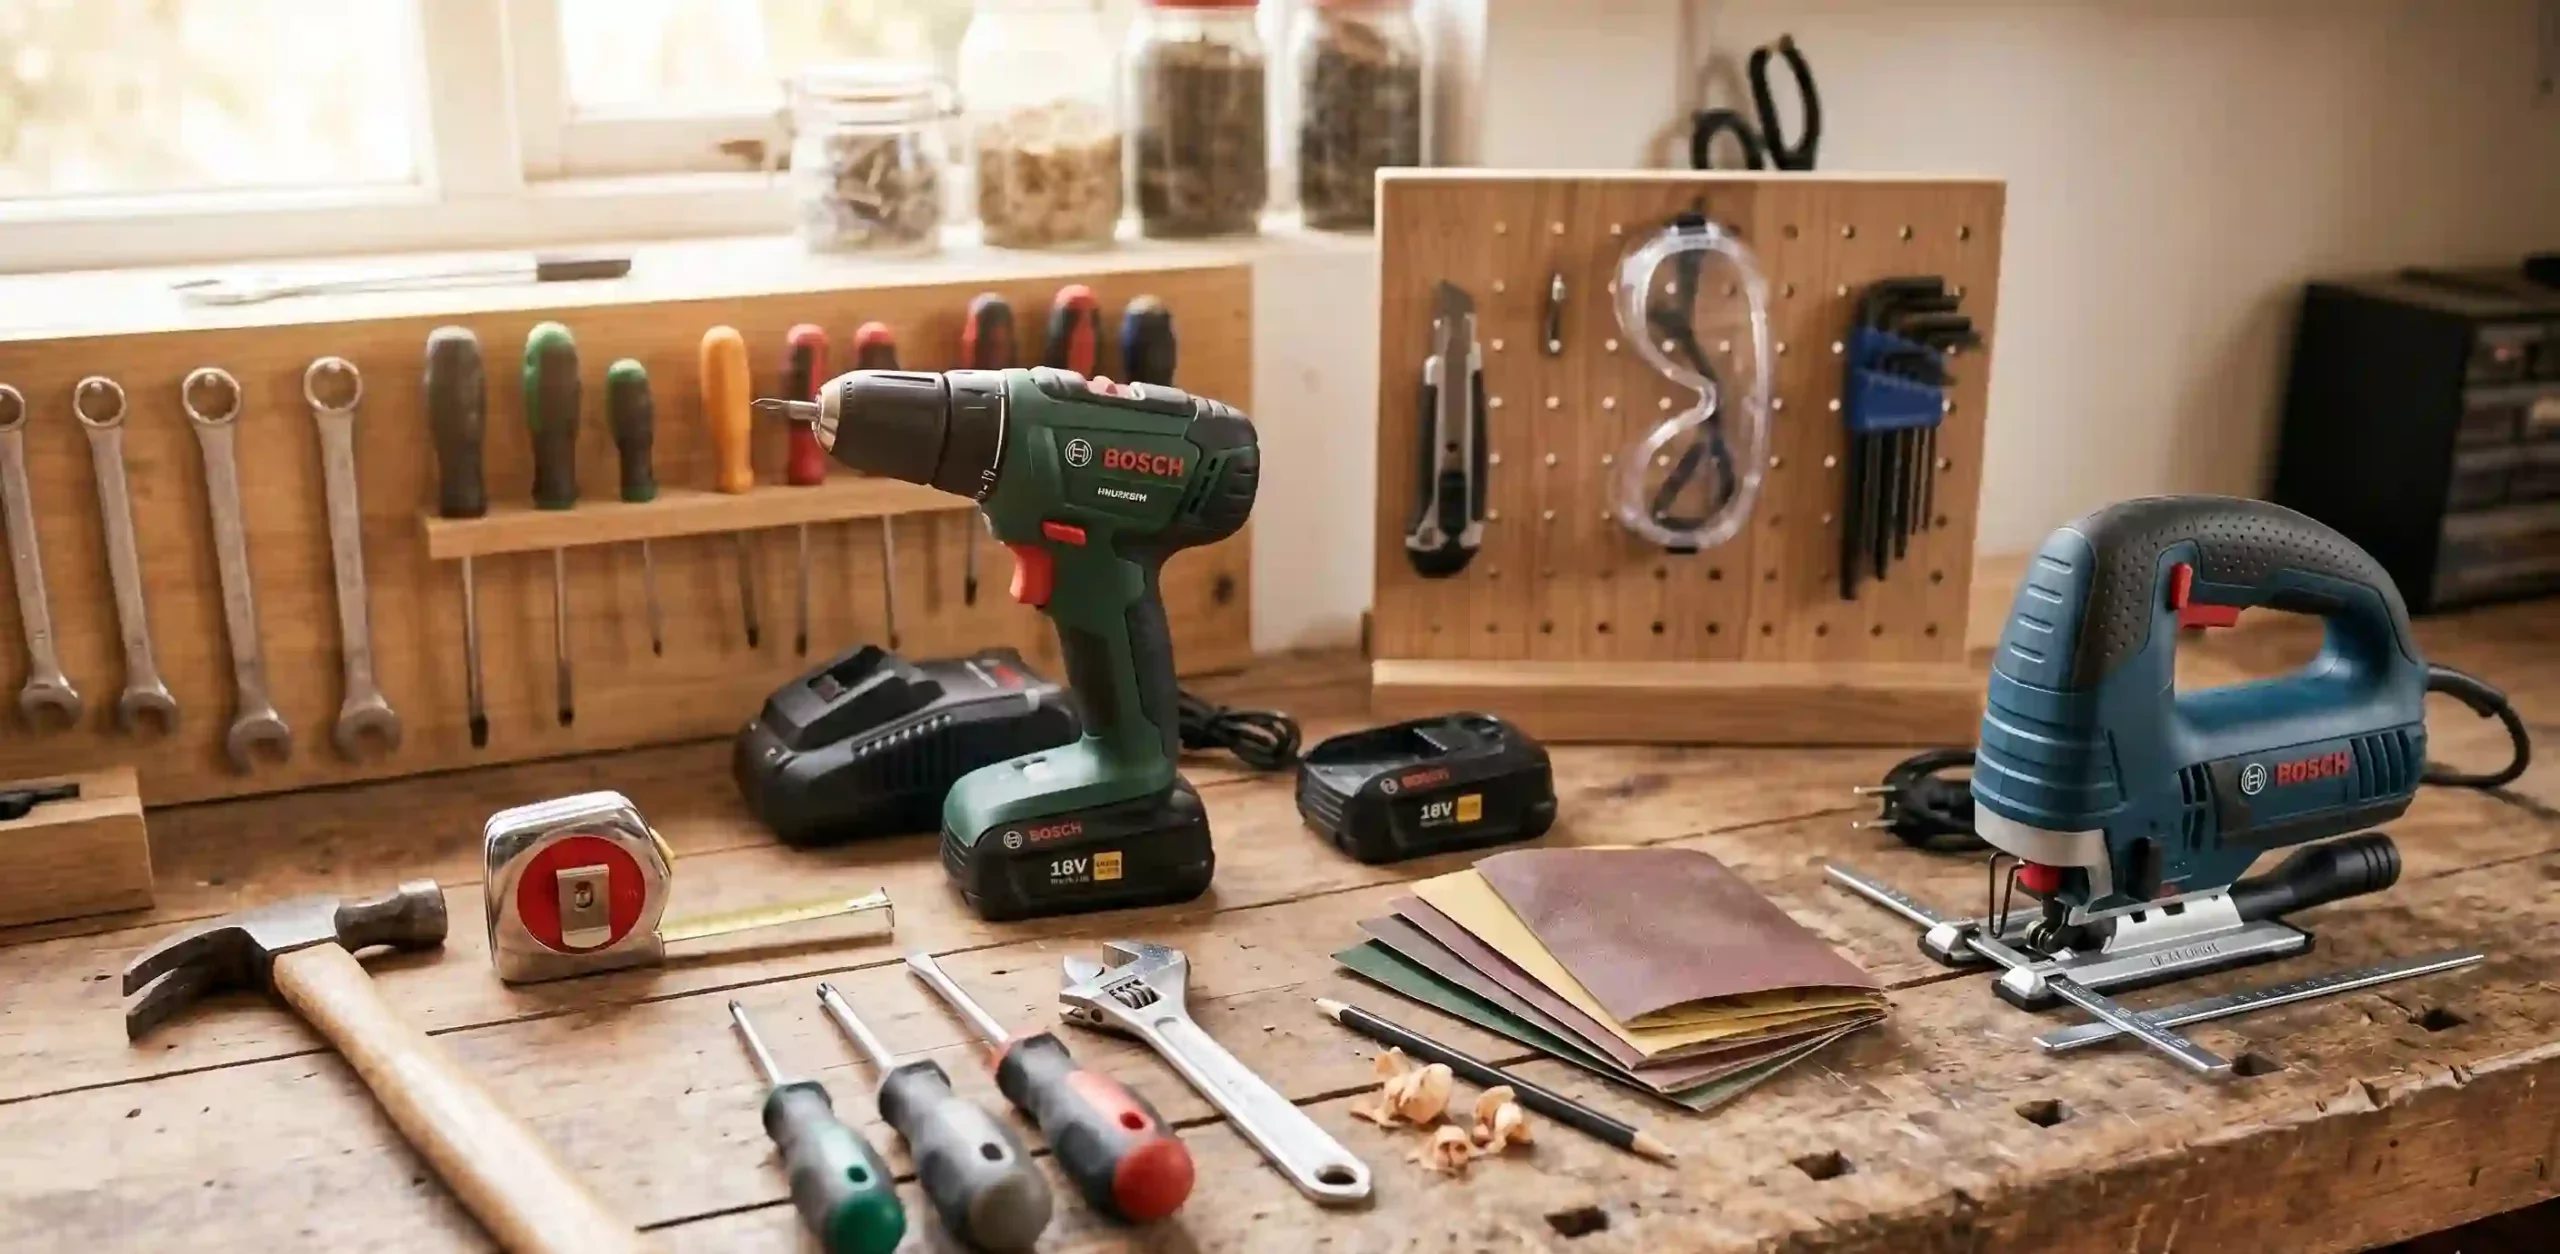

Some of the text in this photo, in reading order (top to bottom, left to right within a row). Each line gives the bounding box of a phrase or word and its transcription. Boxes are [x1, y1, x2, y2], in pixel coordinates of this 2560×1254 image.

[1103, 448, 1184, 477] BOSCH
[2275, 751, 2350, 787] BOSCH
[1420, 801, 1453, 819] 18V
[1029, 821, 1082, 842] BOSCH
[1050, 858, 1087, 876] 18V
